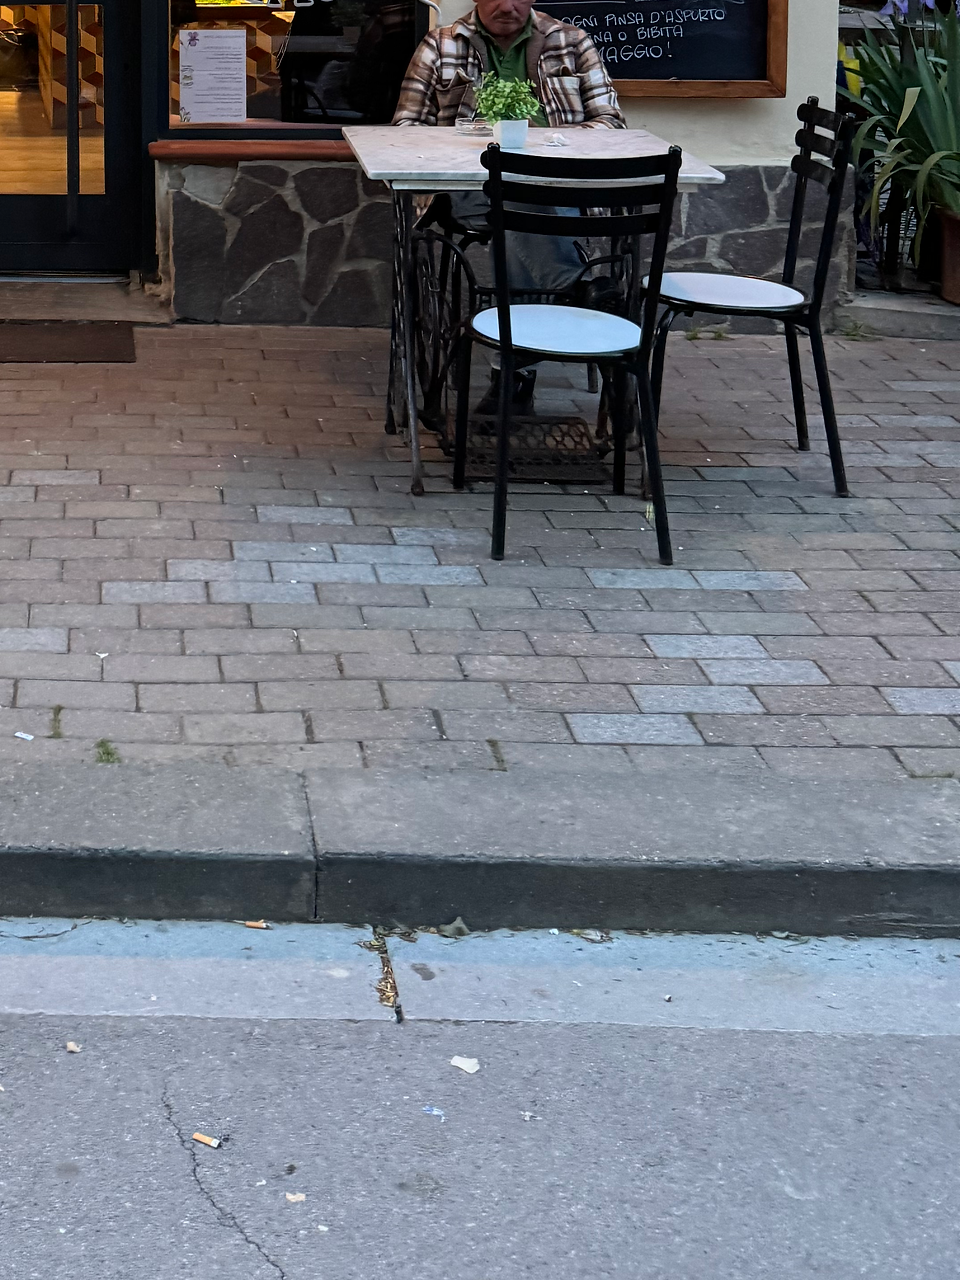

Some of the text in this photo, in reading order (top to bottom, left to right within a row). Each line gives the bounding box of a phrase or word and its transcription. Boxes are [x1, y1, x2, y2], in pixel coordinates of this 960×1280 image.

[604, 11, 644, 27] PINSA
[650, 8, 726, 23] D'ASPORTO
[636, 24, 683, 40] BIBITA
